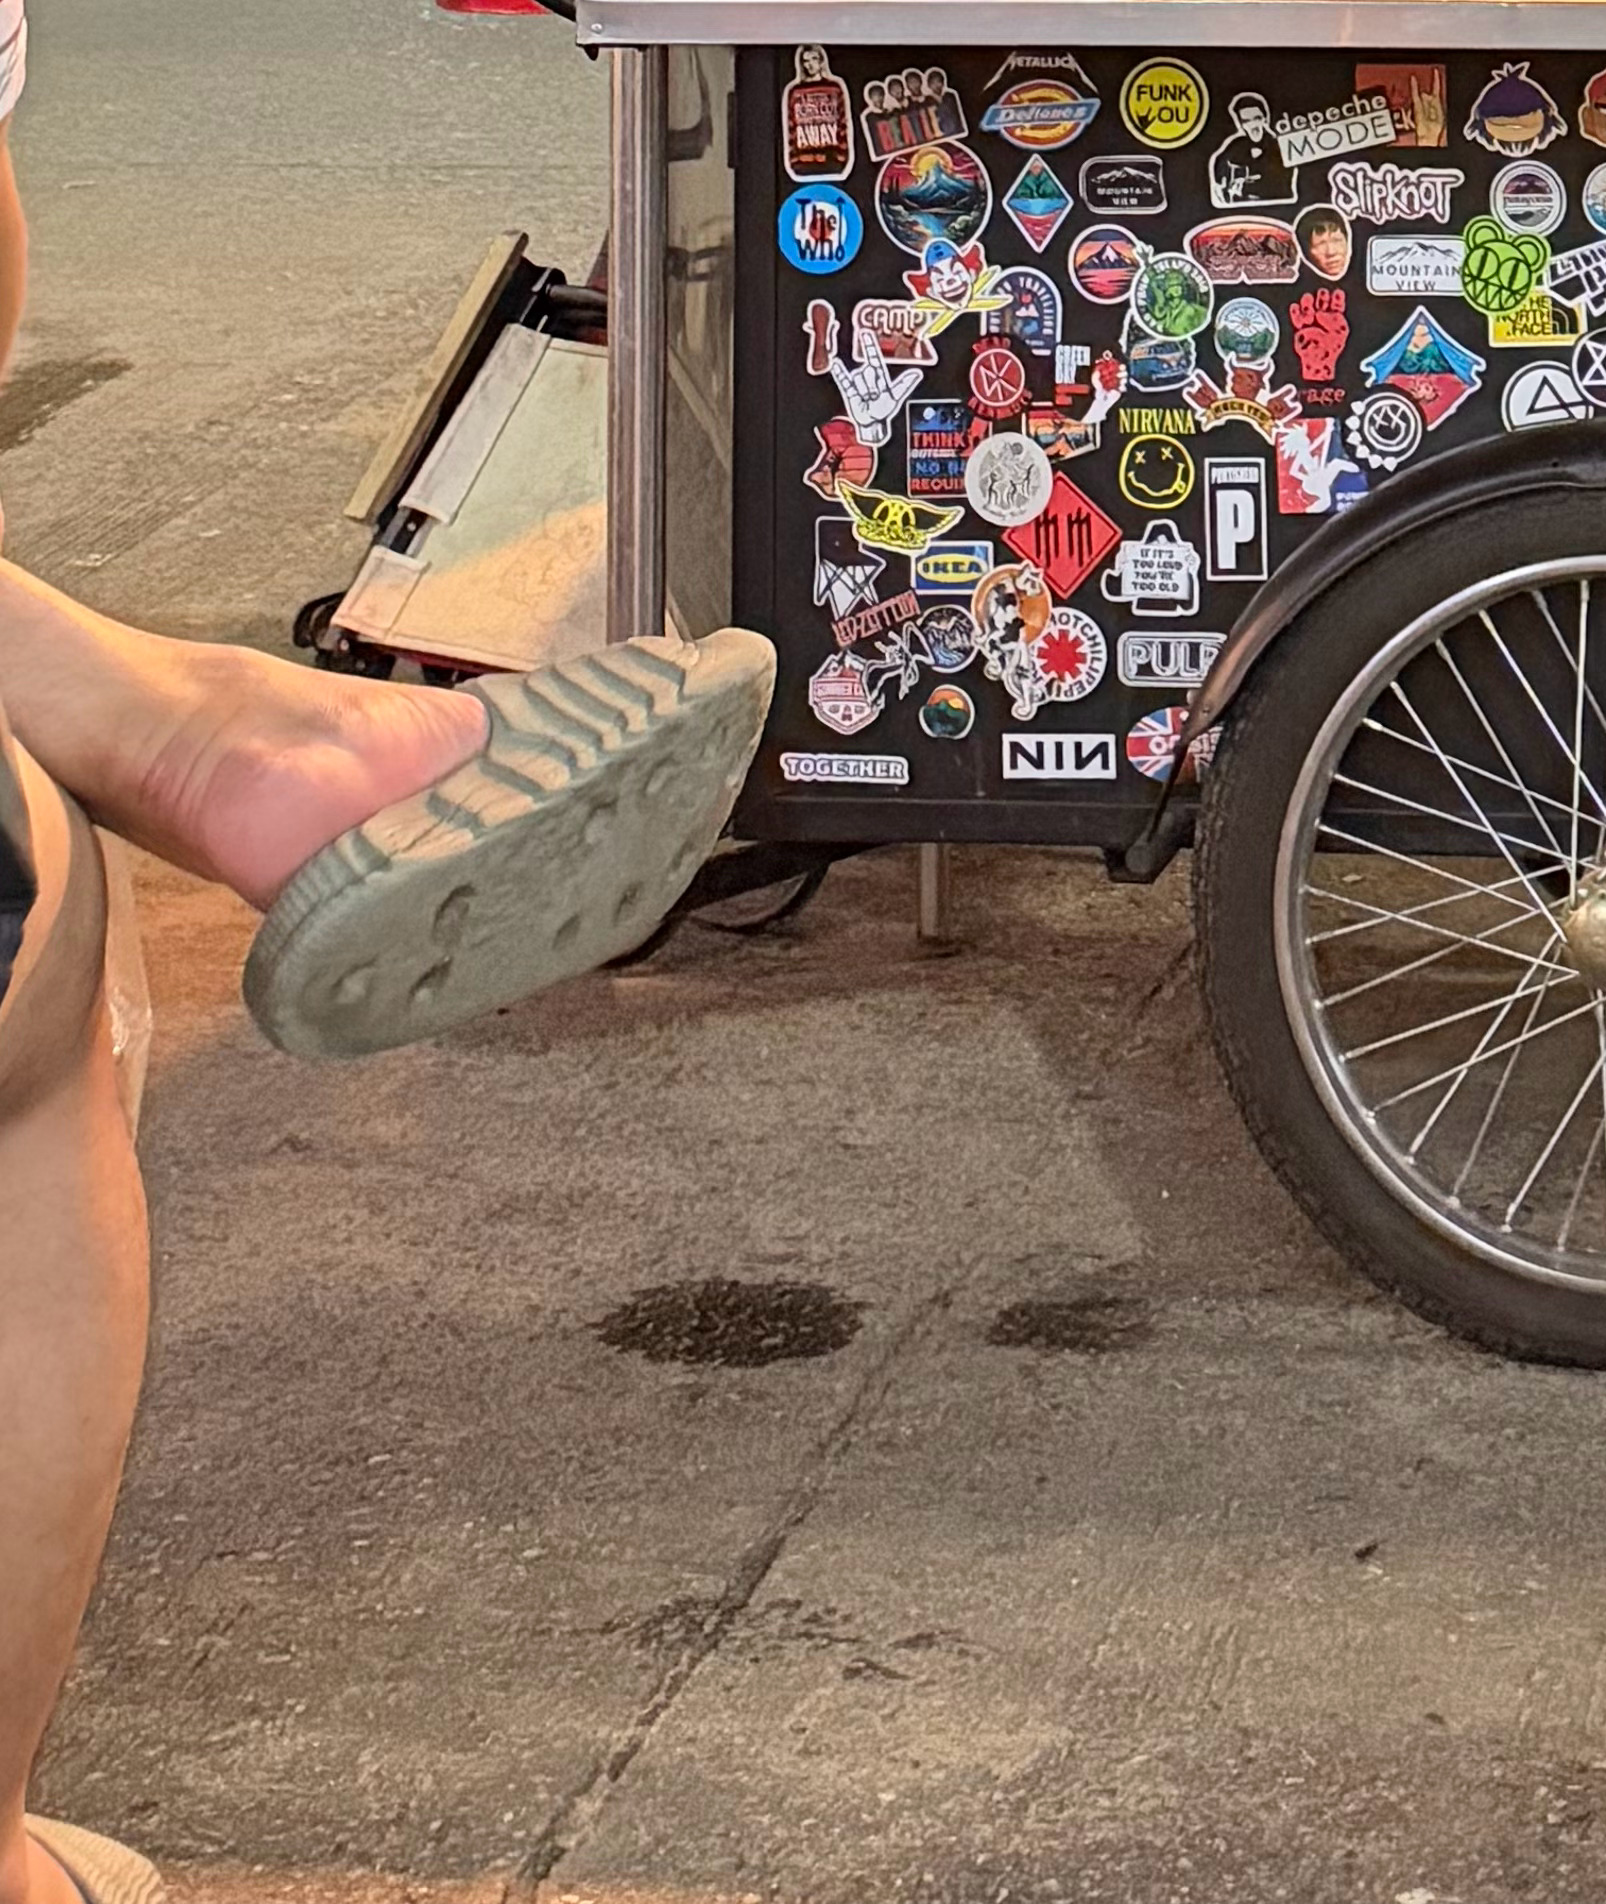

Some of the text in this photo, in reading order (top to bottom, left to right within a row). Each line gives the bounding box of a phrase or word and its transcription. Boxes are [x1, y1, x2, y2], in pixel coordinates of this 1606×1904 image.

[1136, 84, 1192, 102] FUNK
[1275, 94, 1387, 132] depeche
[796, 123, 838, 149] AWAY
[1286, 115, 1392, 163] MODE
[1373, 264, 1462, 277] MOUNTAIN
[1395, 280, 1436, 292] VIEW
[861, 305, 925, 335] CAMP
[1119, 408, 1196, 435] NIRVANA
[912, 432, 966, 448] THINK
[787, 756, 905, 780] TOGETHER
